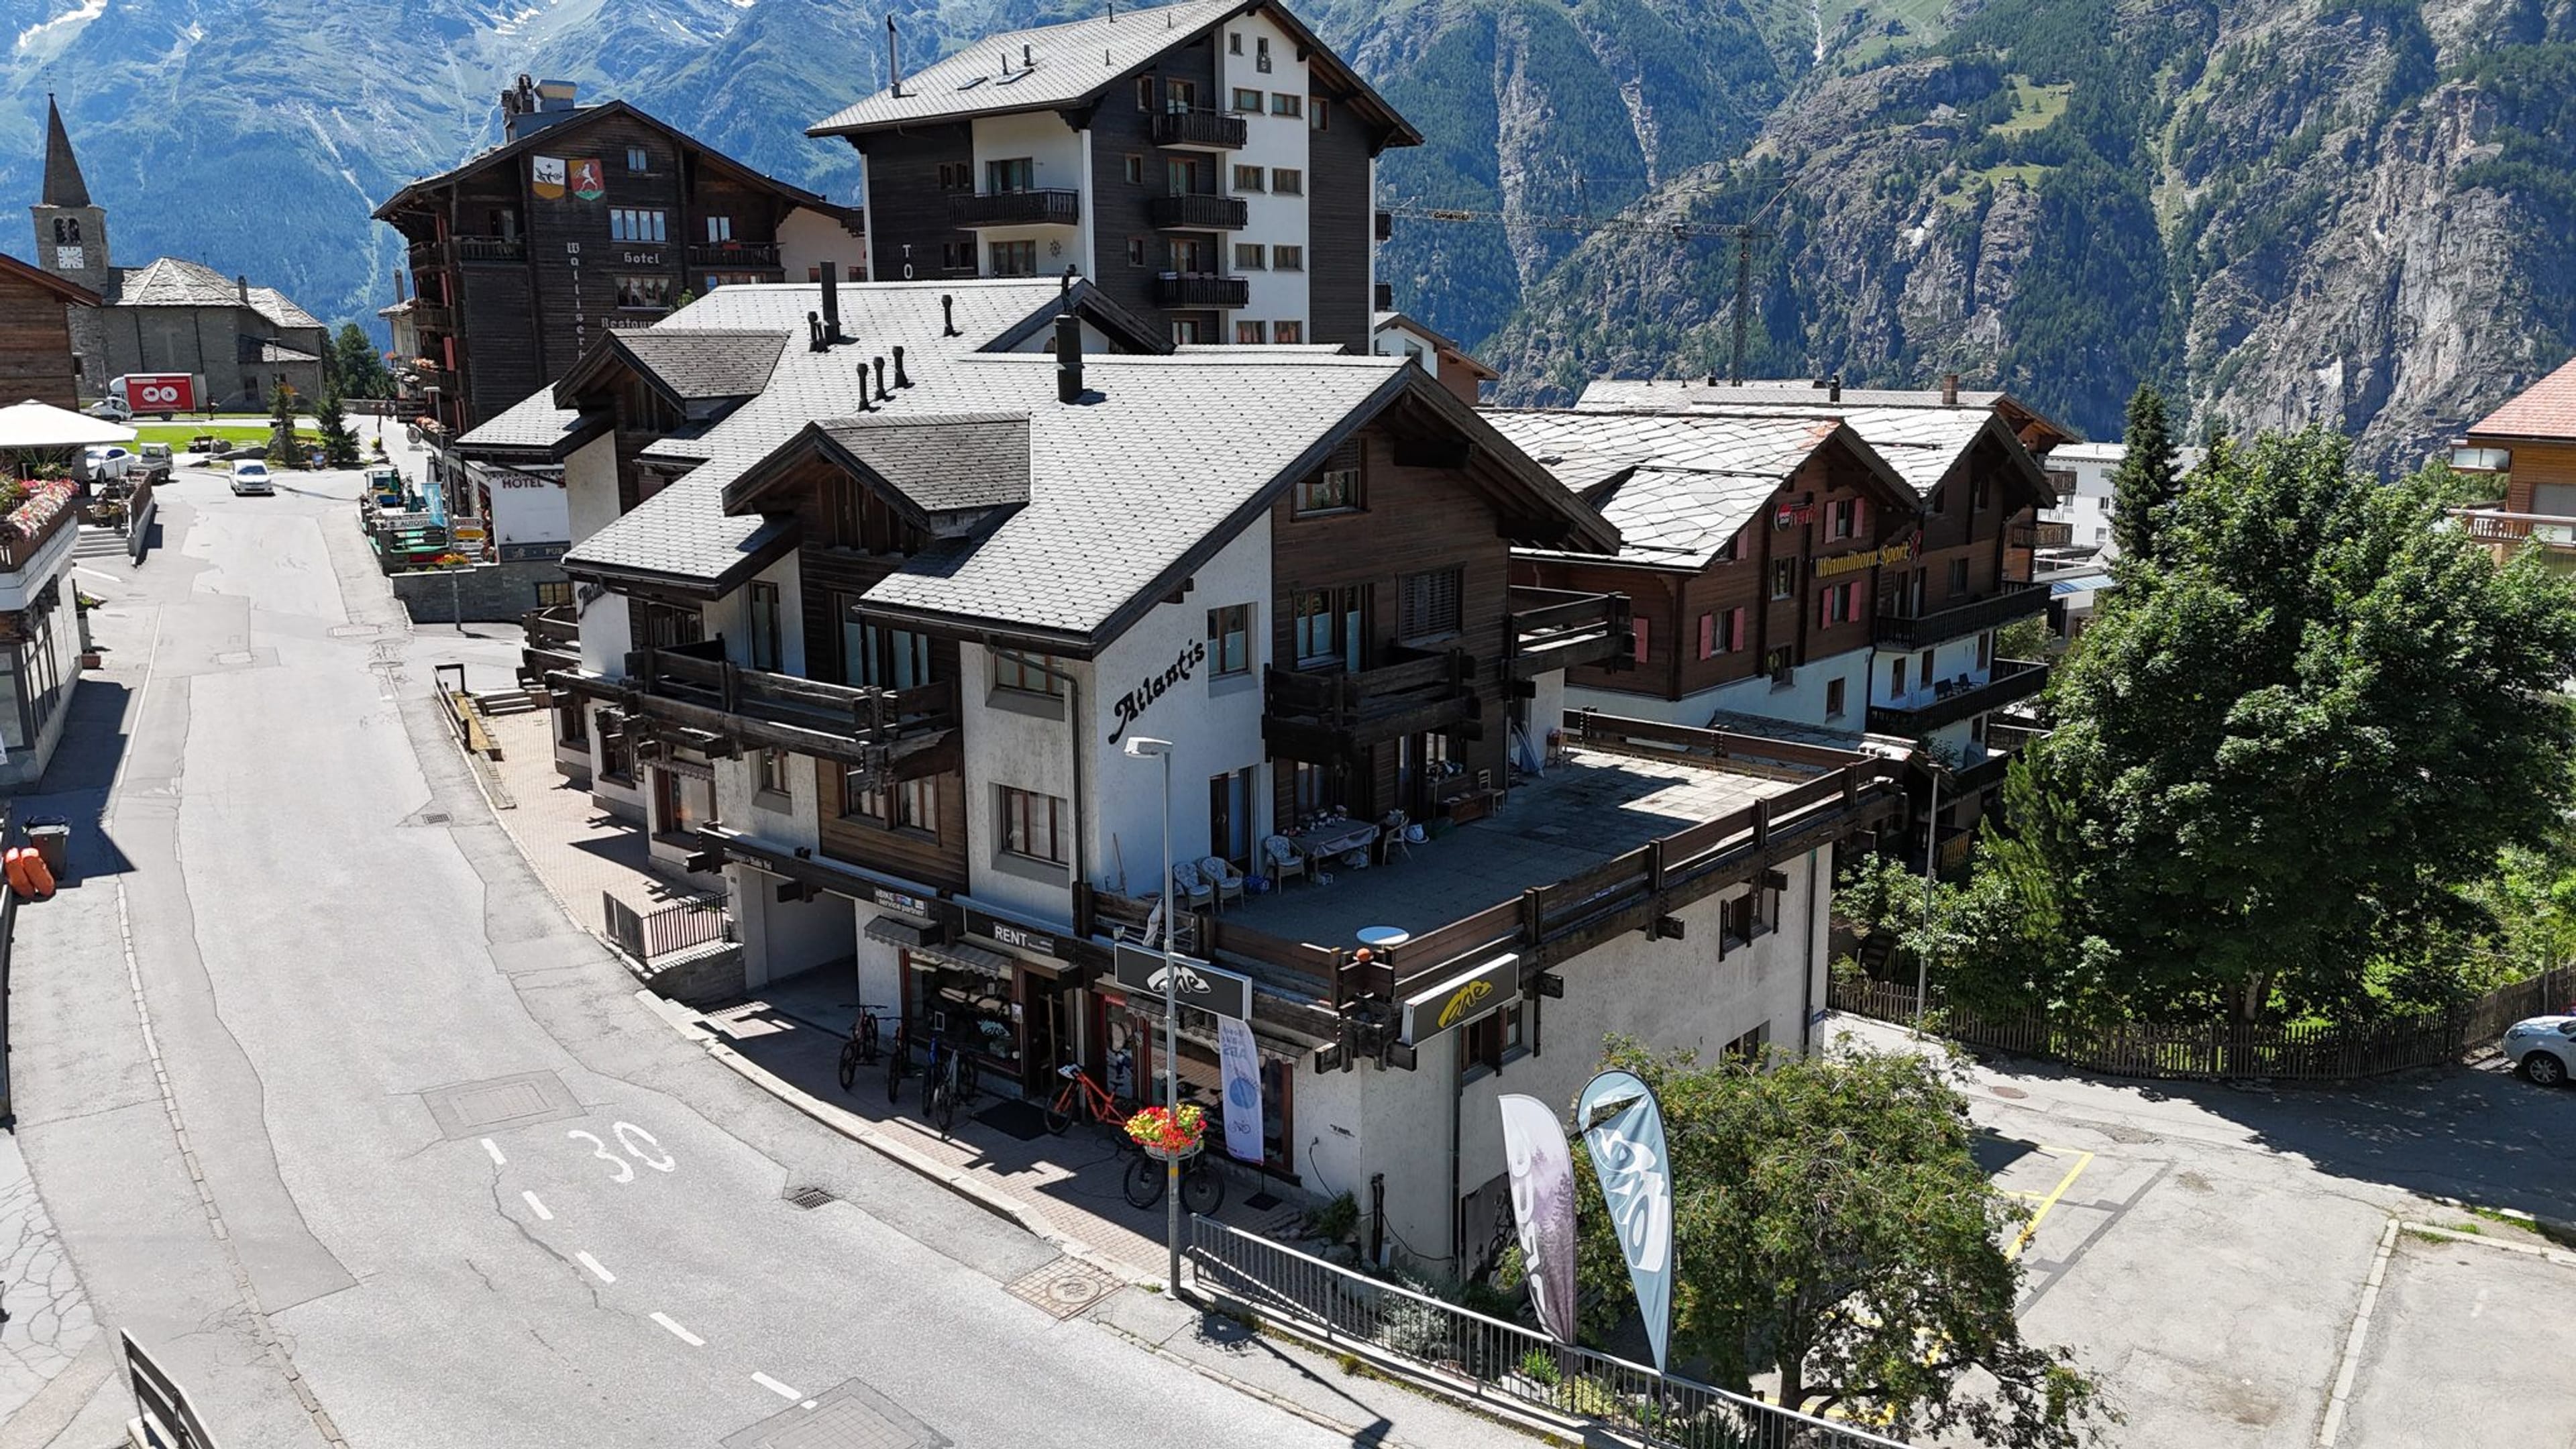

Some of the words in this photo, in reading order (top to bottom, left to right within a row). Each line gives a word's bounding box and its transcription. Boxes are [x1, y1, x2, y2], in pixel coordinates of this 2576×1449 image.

[502, 478, 544, 488] HOTEL
[1108, 639, 1205, 745] Atlantis
[994, 925, 1027, 947] RENT
[568, 1120, 676, 1183] 30
